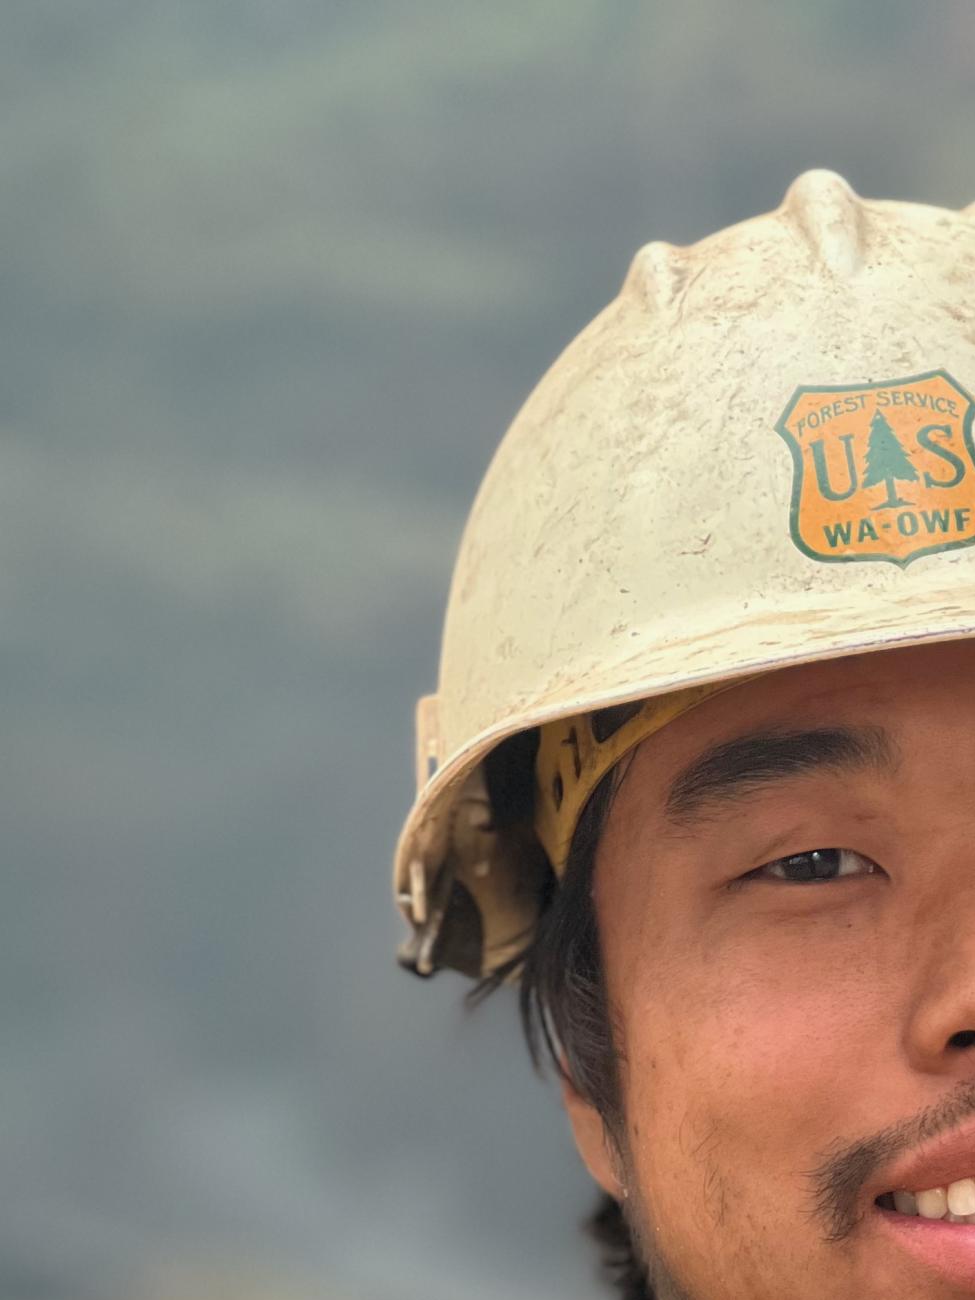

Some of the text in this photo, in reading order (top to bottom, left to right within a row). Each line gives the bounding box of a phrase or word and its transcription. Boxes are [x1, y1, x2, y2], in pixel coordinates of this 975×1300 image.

[796, 391, 960, 437] FOREST SERVICE
[823, 508, 971, 548] WA-OWF
